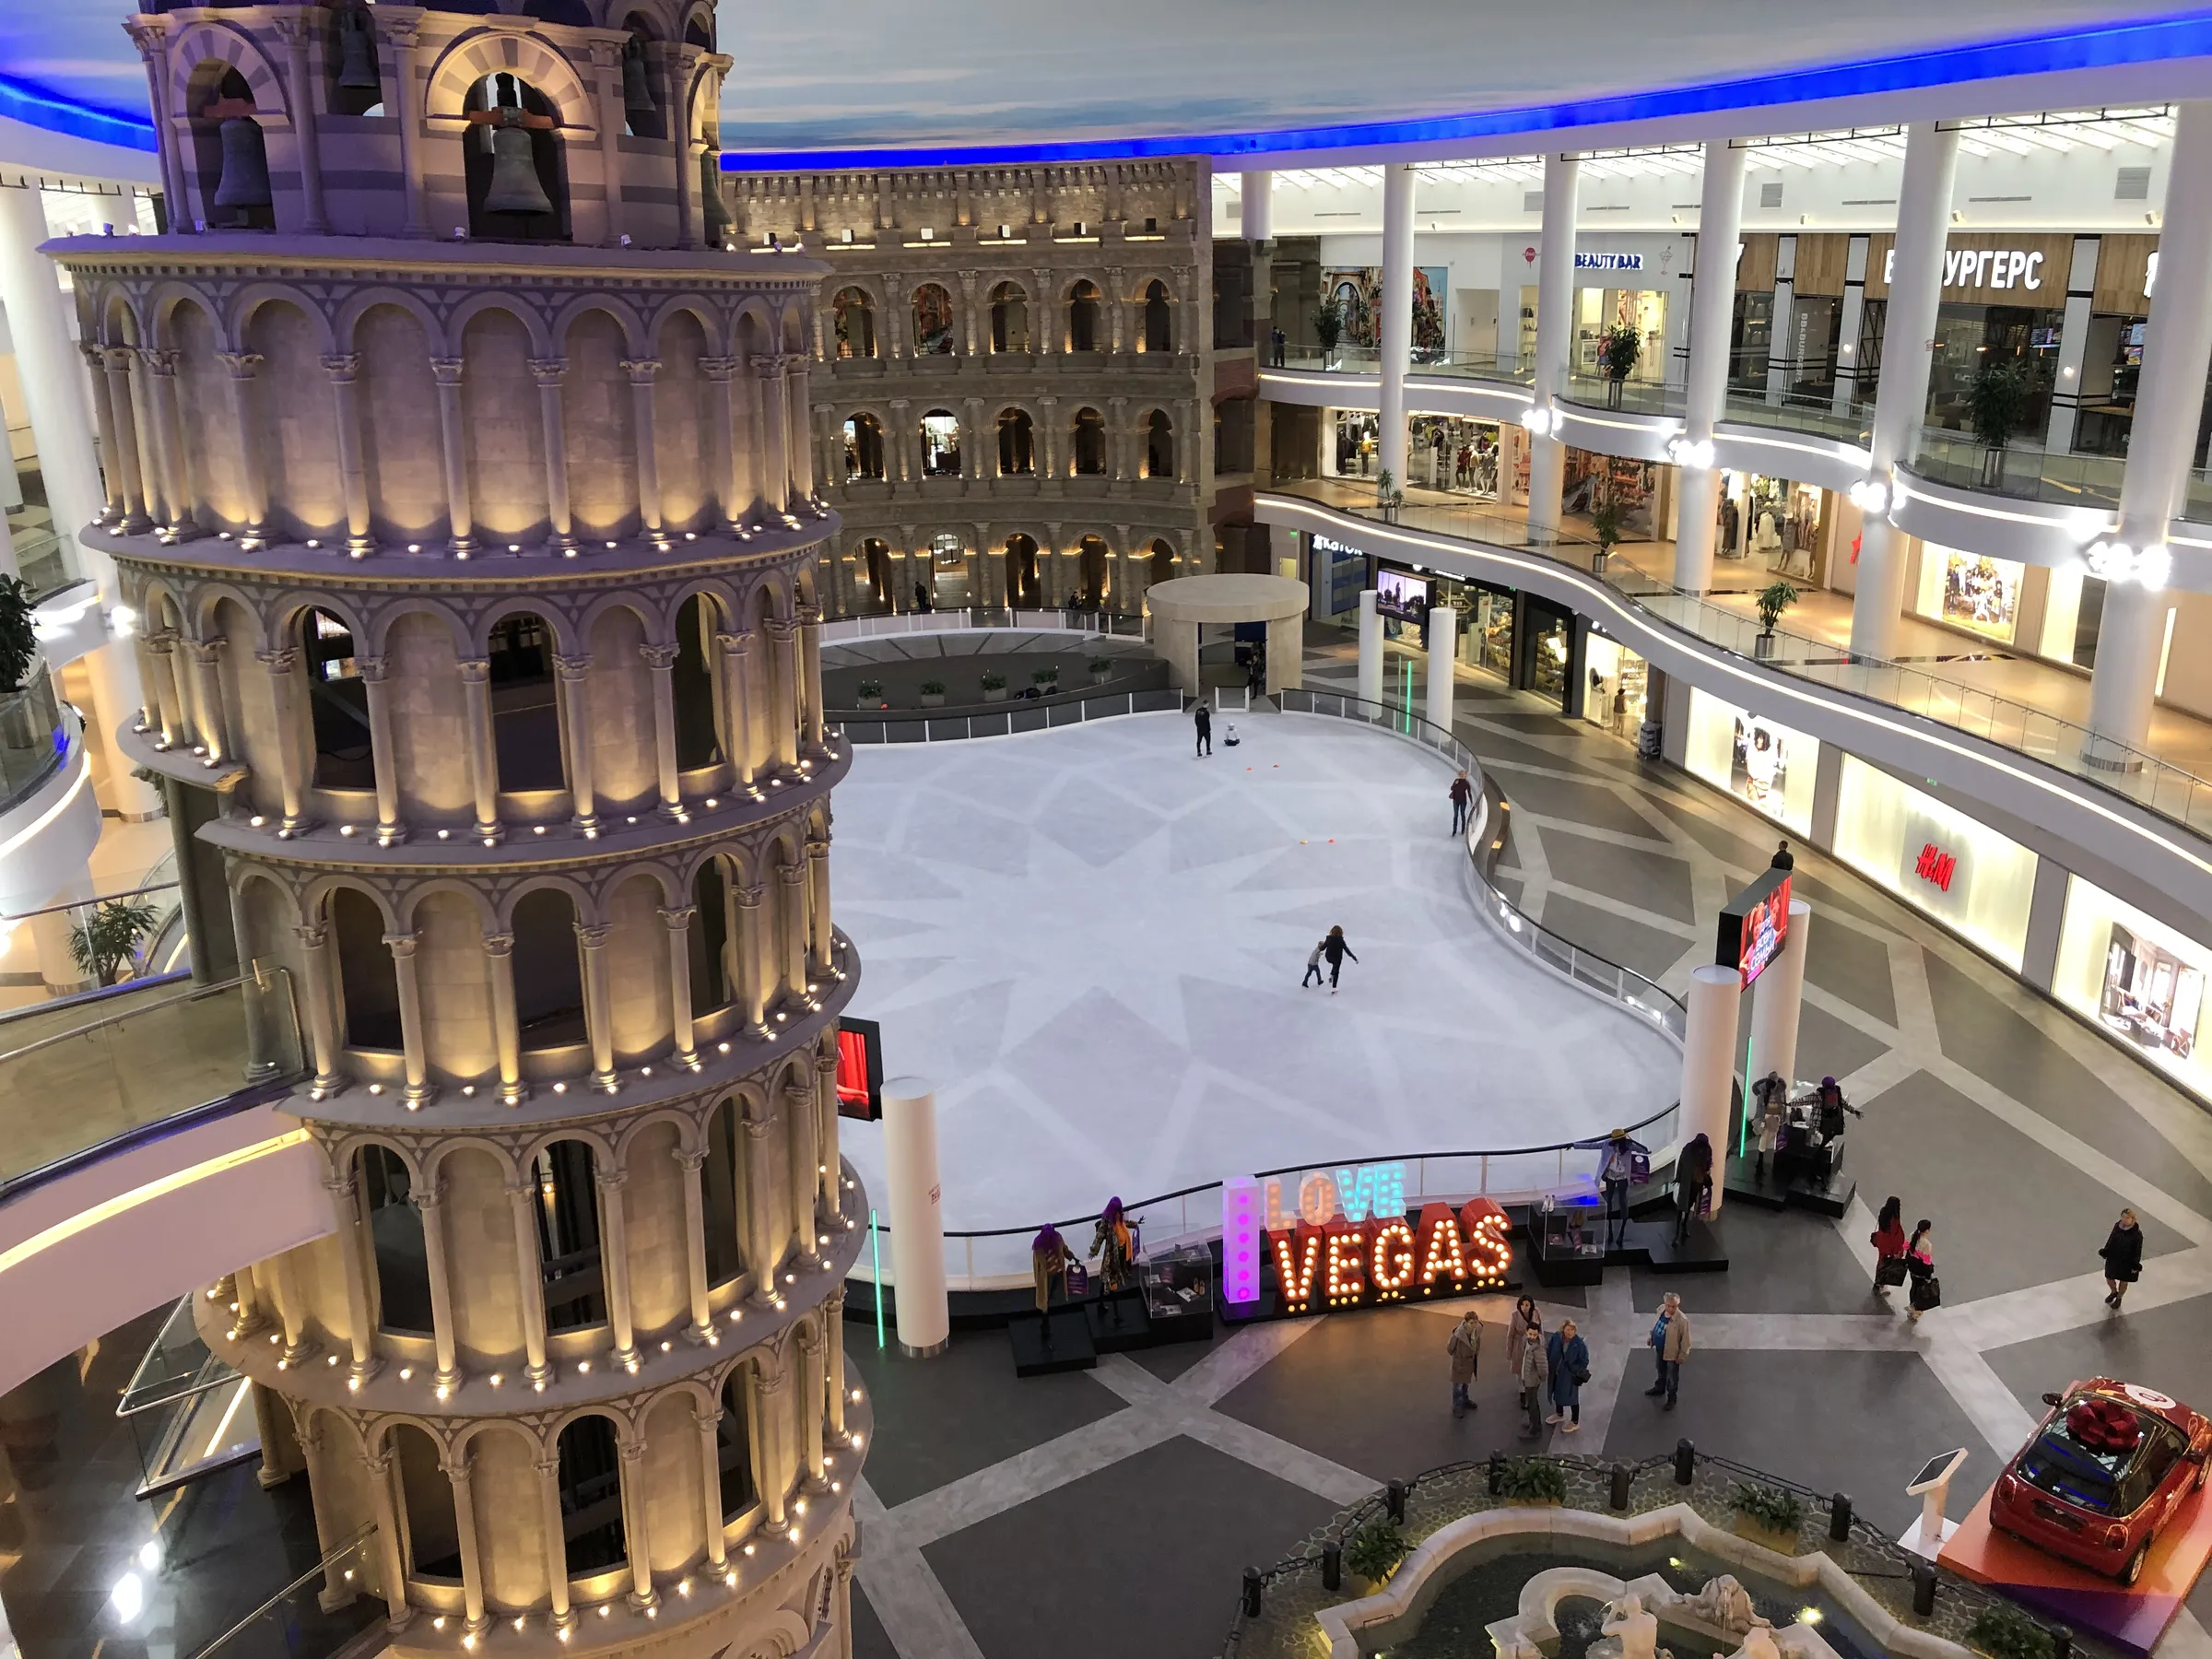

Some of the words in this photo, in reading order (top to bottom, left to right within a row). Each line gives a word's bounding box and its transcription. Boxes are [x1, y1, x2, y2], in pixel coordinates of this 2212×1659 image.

[1574, 253, 1618, 269] BEAUTY
[1618, 254, 1643, 270] BAR
[1943, 250, 2043, 290] УРГЕРС
[1915, 843, 1956, 891] H&M
[1265, 1162, 1406, 1230] LOVE
[1267, 1197, 1512, 1301] VEGAS
